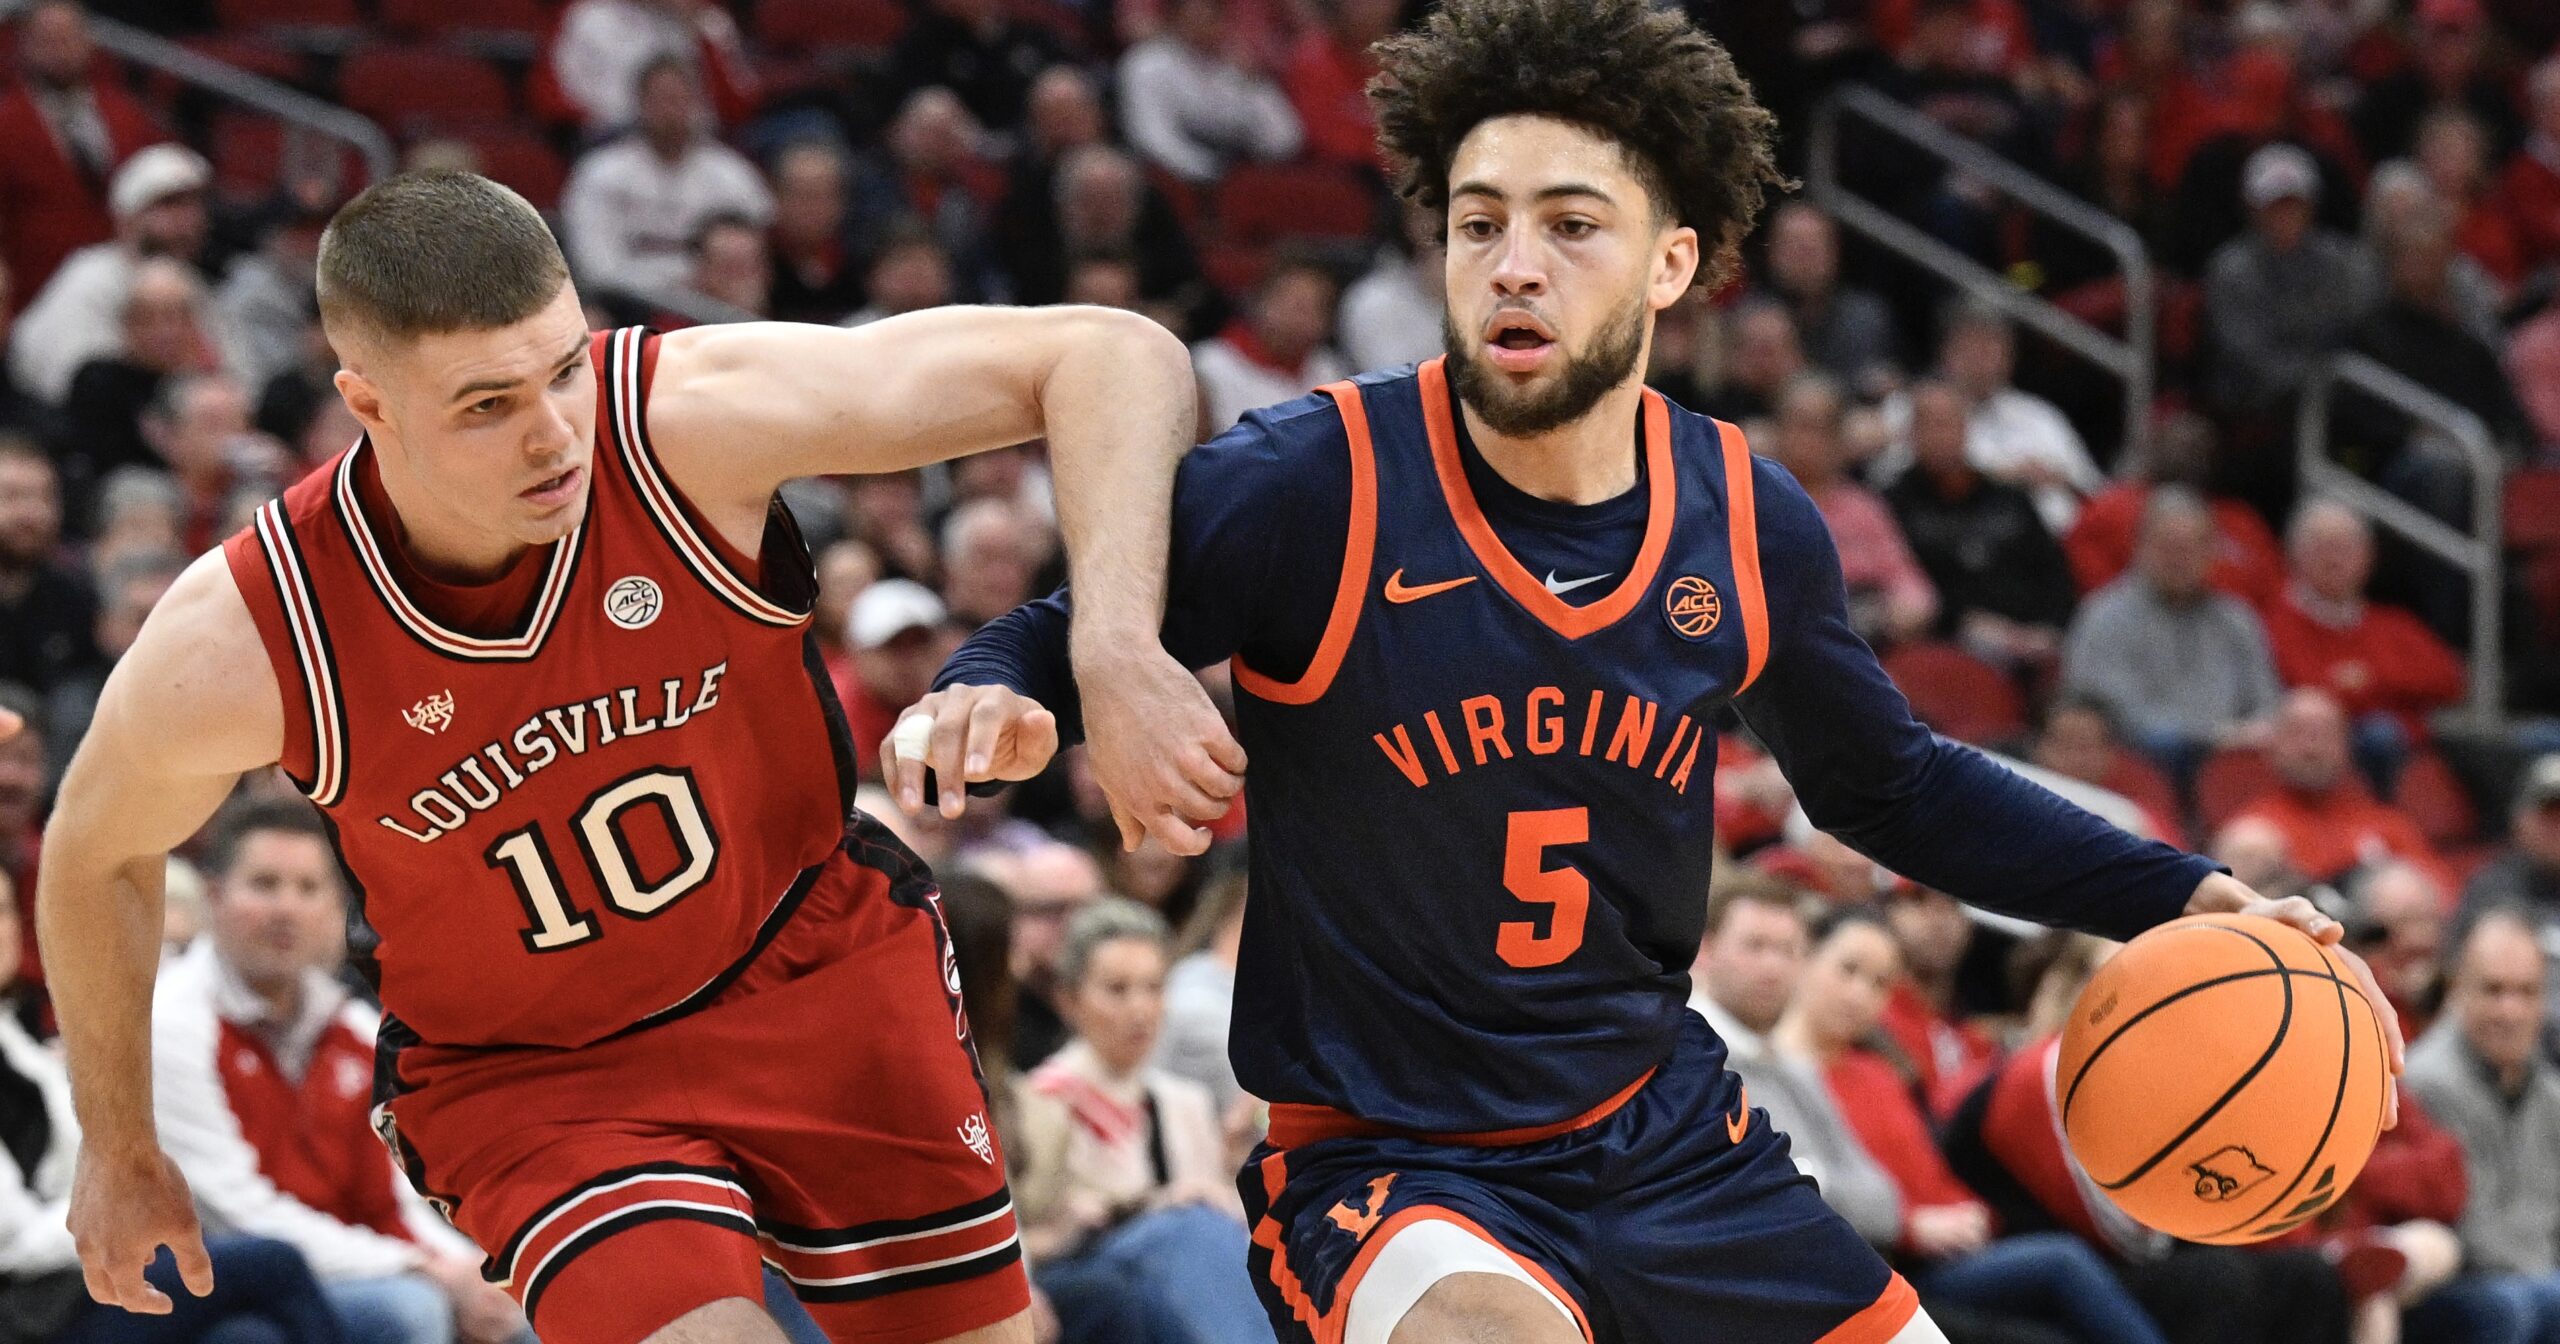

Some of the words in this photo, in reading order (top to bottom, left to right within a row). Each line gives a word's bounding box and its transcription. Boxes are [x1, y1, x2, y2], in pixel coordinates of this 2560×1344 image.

[615, 585, 653, 609] ACC
[1673, 594, 1716, 611] ACC
[378, 660, 728, 843] LOUISVILLE
[1373, 686, 1702, 794] VIRGINIA
[486, 766, 718, 952] 10
[1496, 806, 1589, 967] 5
